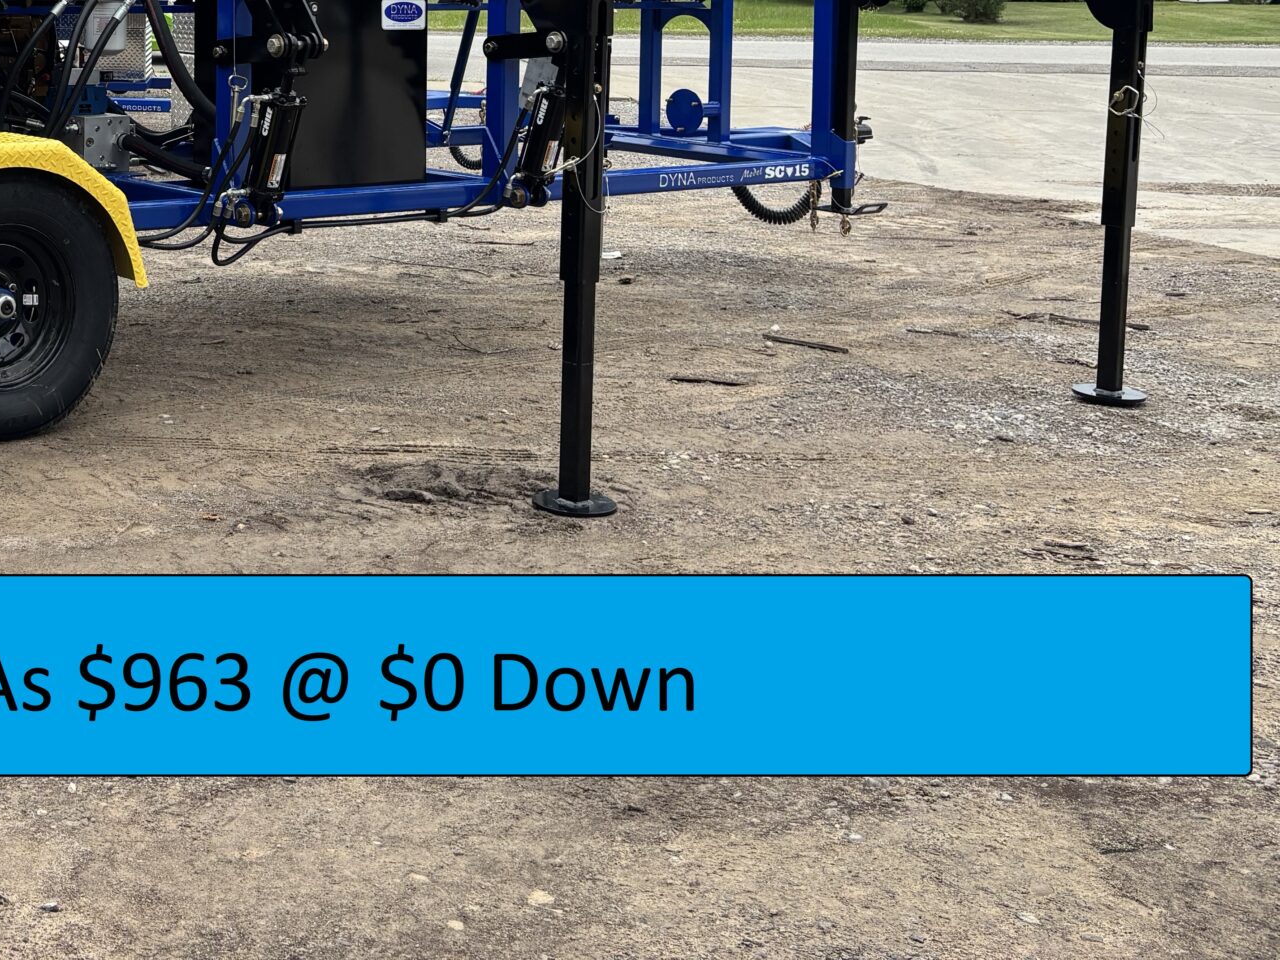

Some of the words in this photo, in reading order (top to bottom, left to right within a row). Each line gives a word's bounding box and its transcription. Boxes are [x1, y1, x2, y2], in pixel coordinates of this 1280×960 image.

[390, 4, 418, 14] DYNA
[659, 171, 697, 188] DYNA
[697, 174, 735, 185] PRODUCTS
[740, 166, 763, 182] Model
